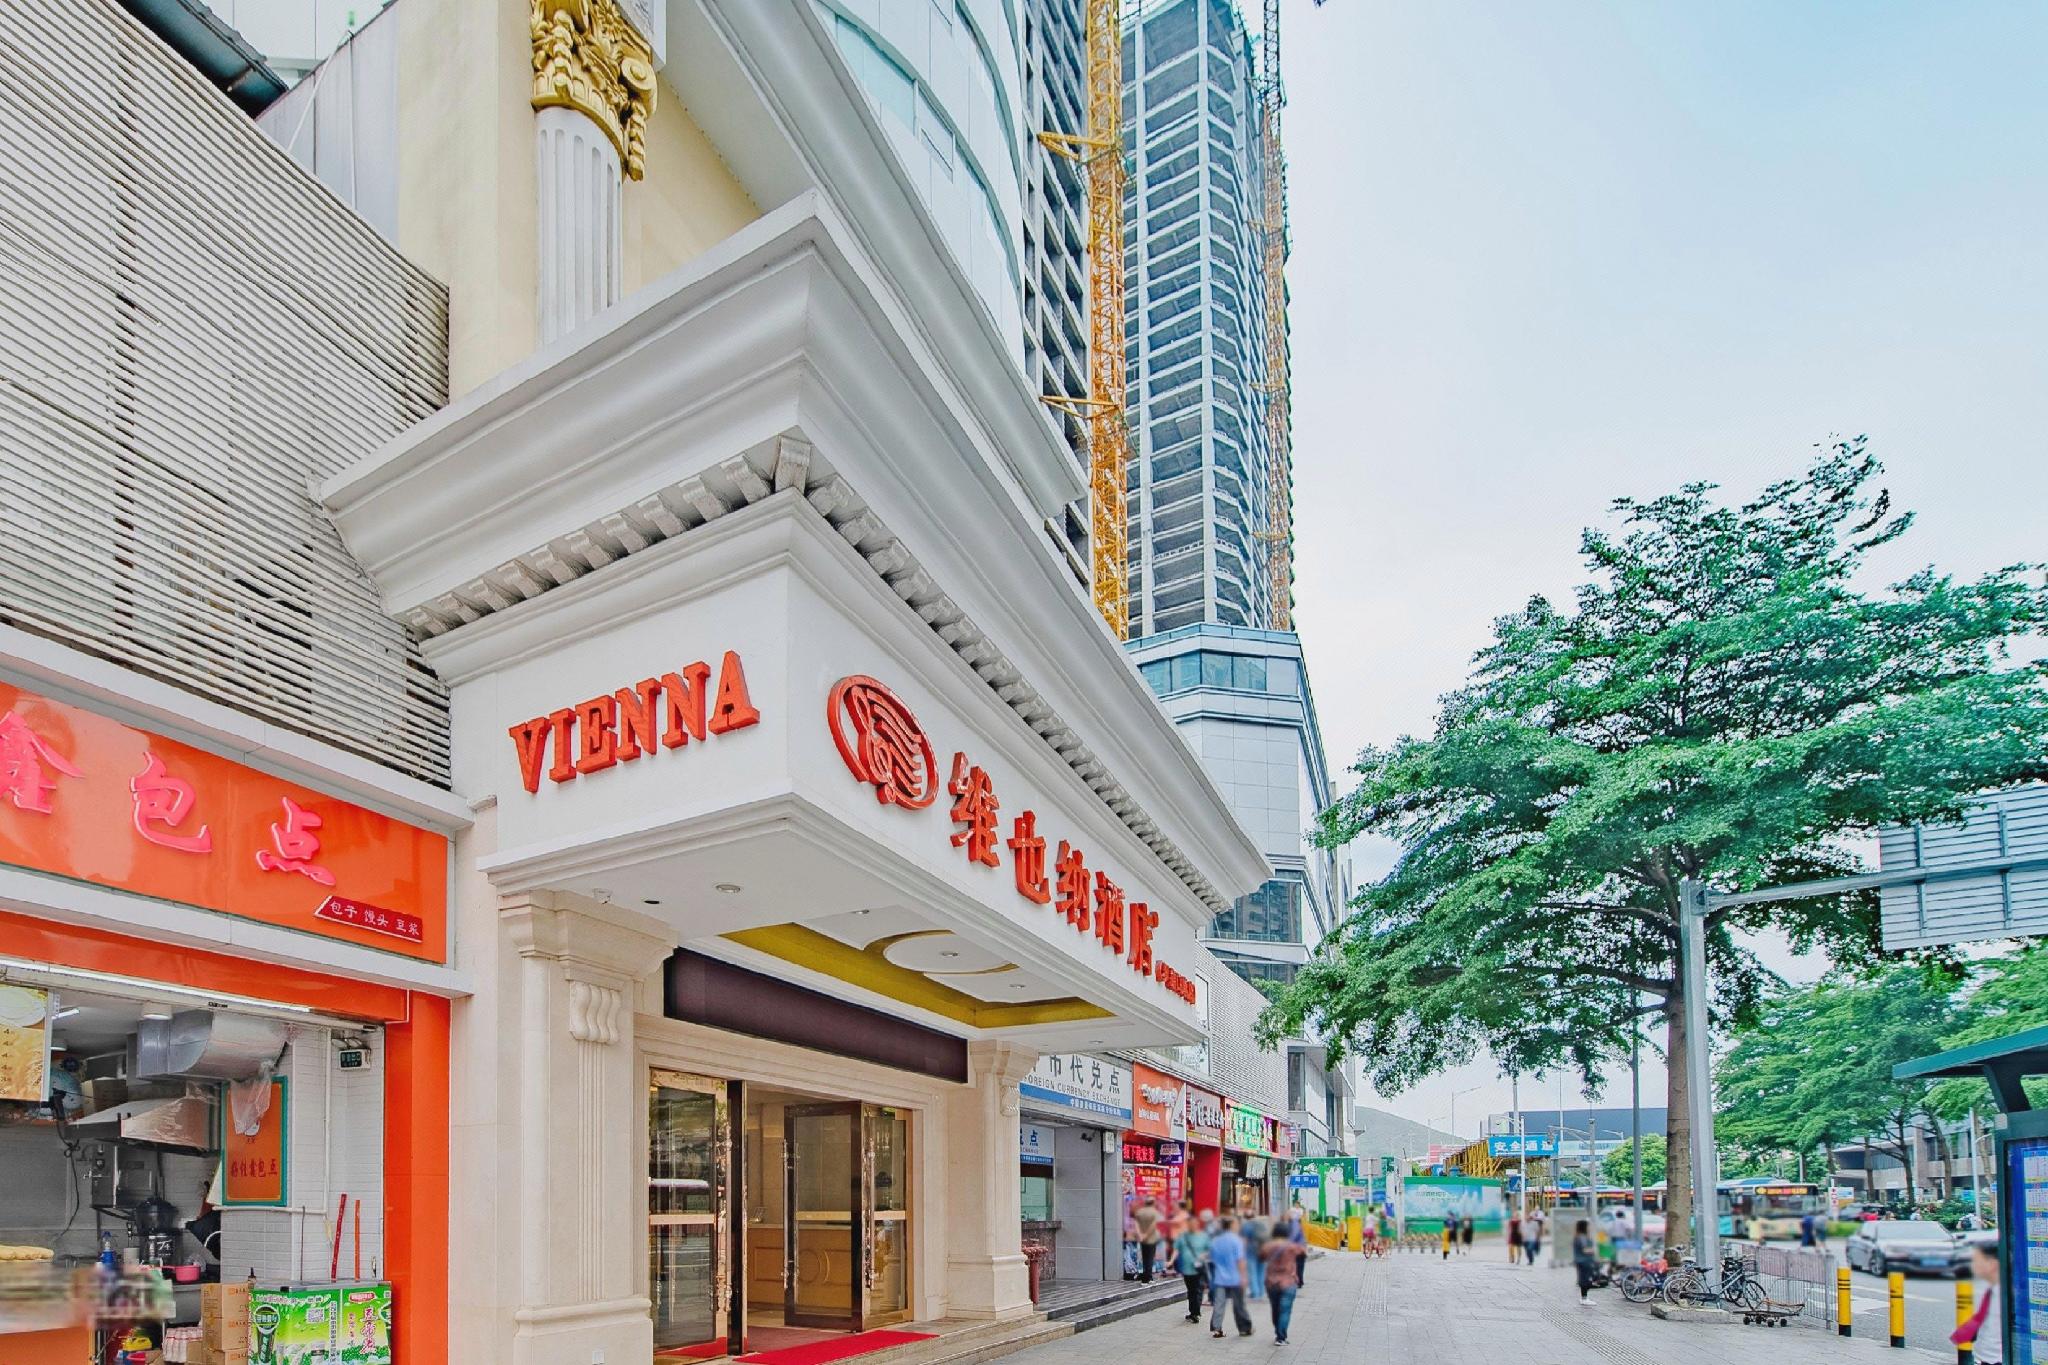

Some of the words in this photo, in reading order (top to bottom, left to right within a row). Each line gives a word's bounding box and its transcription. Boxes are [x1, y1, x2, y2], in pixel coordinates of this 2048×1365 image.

[509, 650, 760, 793] VIENNA
[948, 752, 1159, 976] 维也纳酒店
[330, 901, 357, 918] 包子
[364, 909, 388, 927] 馒头
[396, 919, 419, 936] 豆浆
[1033, 1055, 1120, 1094] 币代兑点
[1058, 1082, 1090, 1098] CURRENCY
[1092, 1091, 1121, 1106] EXCHANGE
[1494, 1140, 1554, 1153] 安全通道
